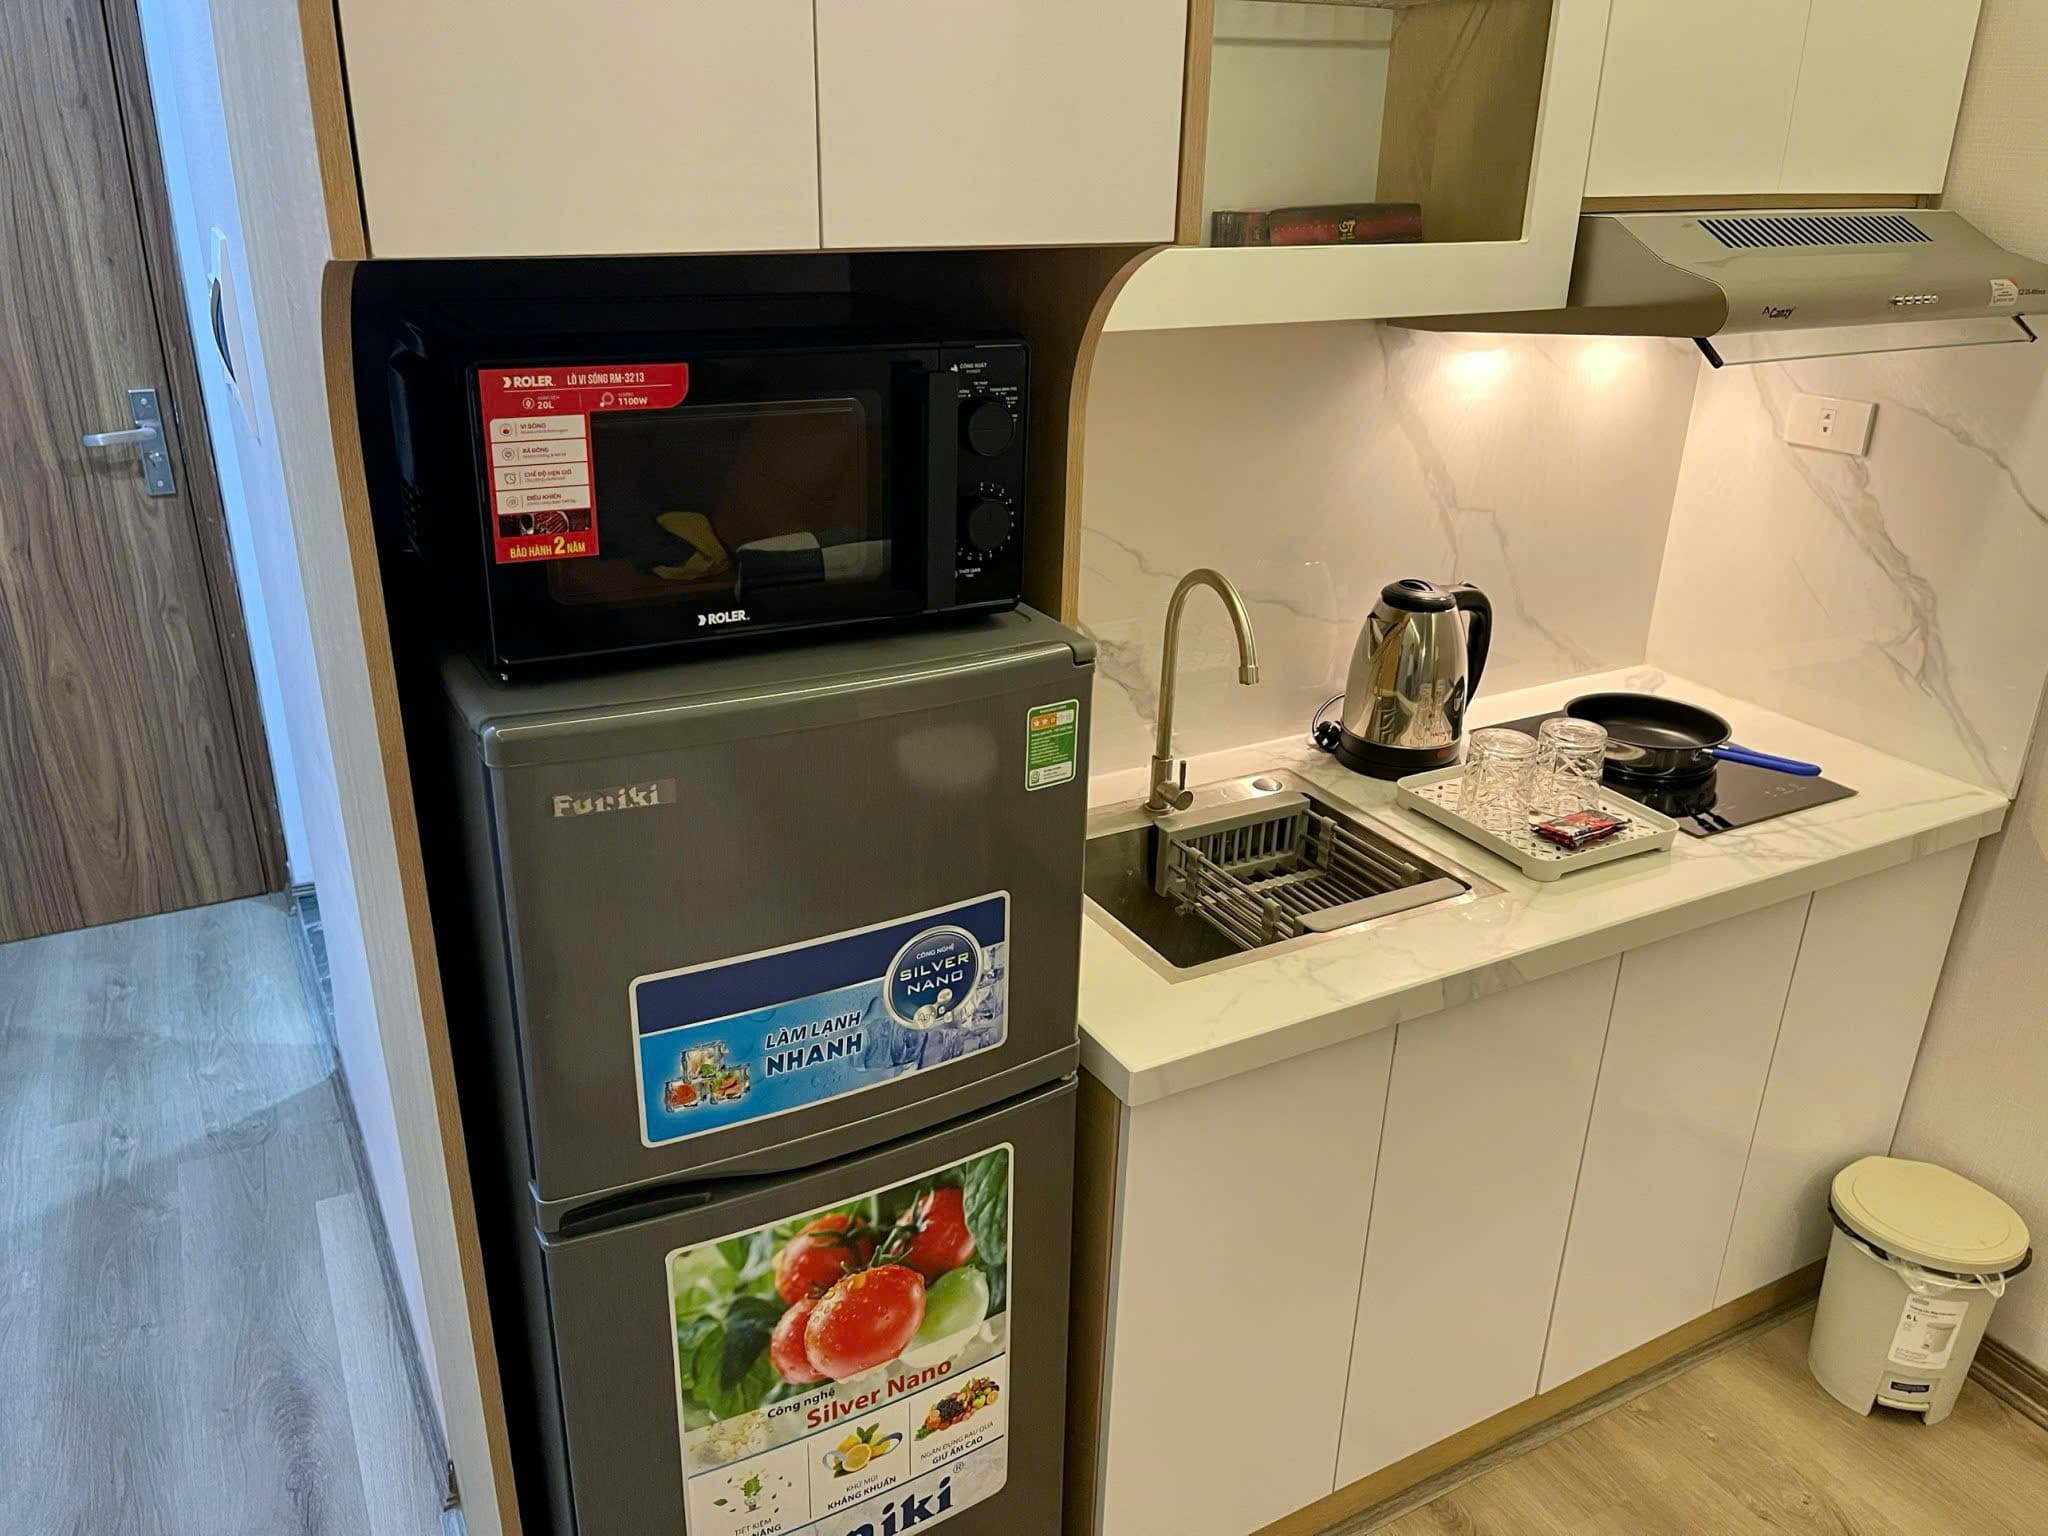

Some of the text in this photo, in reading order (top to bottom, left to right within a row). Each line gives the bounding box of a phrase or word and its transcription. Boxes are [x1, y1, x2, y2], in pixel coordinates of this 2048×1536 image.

[514, 376, 553, 388] ROLER
[567, 372, 645, 385] LÒ VI SÓNG RM-3213
[537, 401, 554, 410] 20L
[618, 397, 648, 406] 1100W
[510, 544, 527, 559] BẢO
[529, 544, 552, 557] HÀNH
[554, 536, 566, 554] 2
[708, 610, 746, 625] ROLER
[916, 949, 935, 960] CÔNG
[900, 952, 969, 981] SILVER
[907, 969, 963, 995] NANO
[766, 1011, 861, 1049] LÀM LẠNH
[766, 1033, 862, 1076] NHANH
[767, 1386, 836, 1418] Công nghệ
[807, 1360, 952, 1429] Silver Nano
[965, 1435, 983, 1448] CAO
[827, 1475, 897, 1510] KHÁNG KHUẨN
